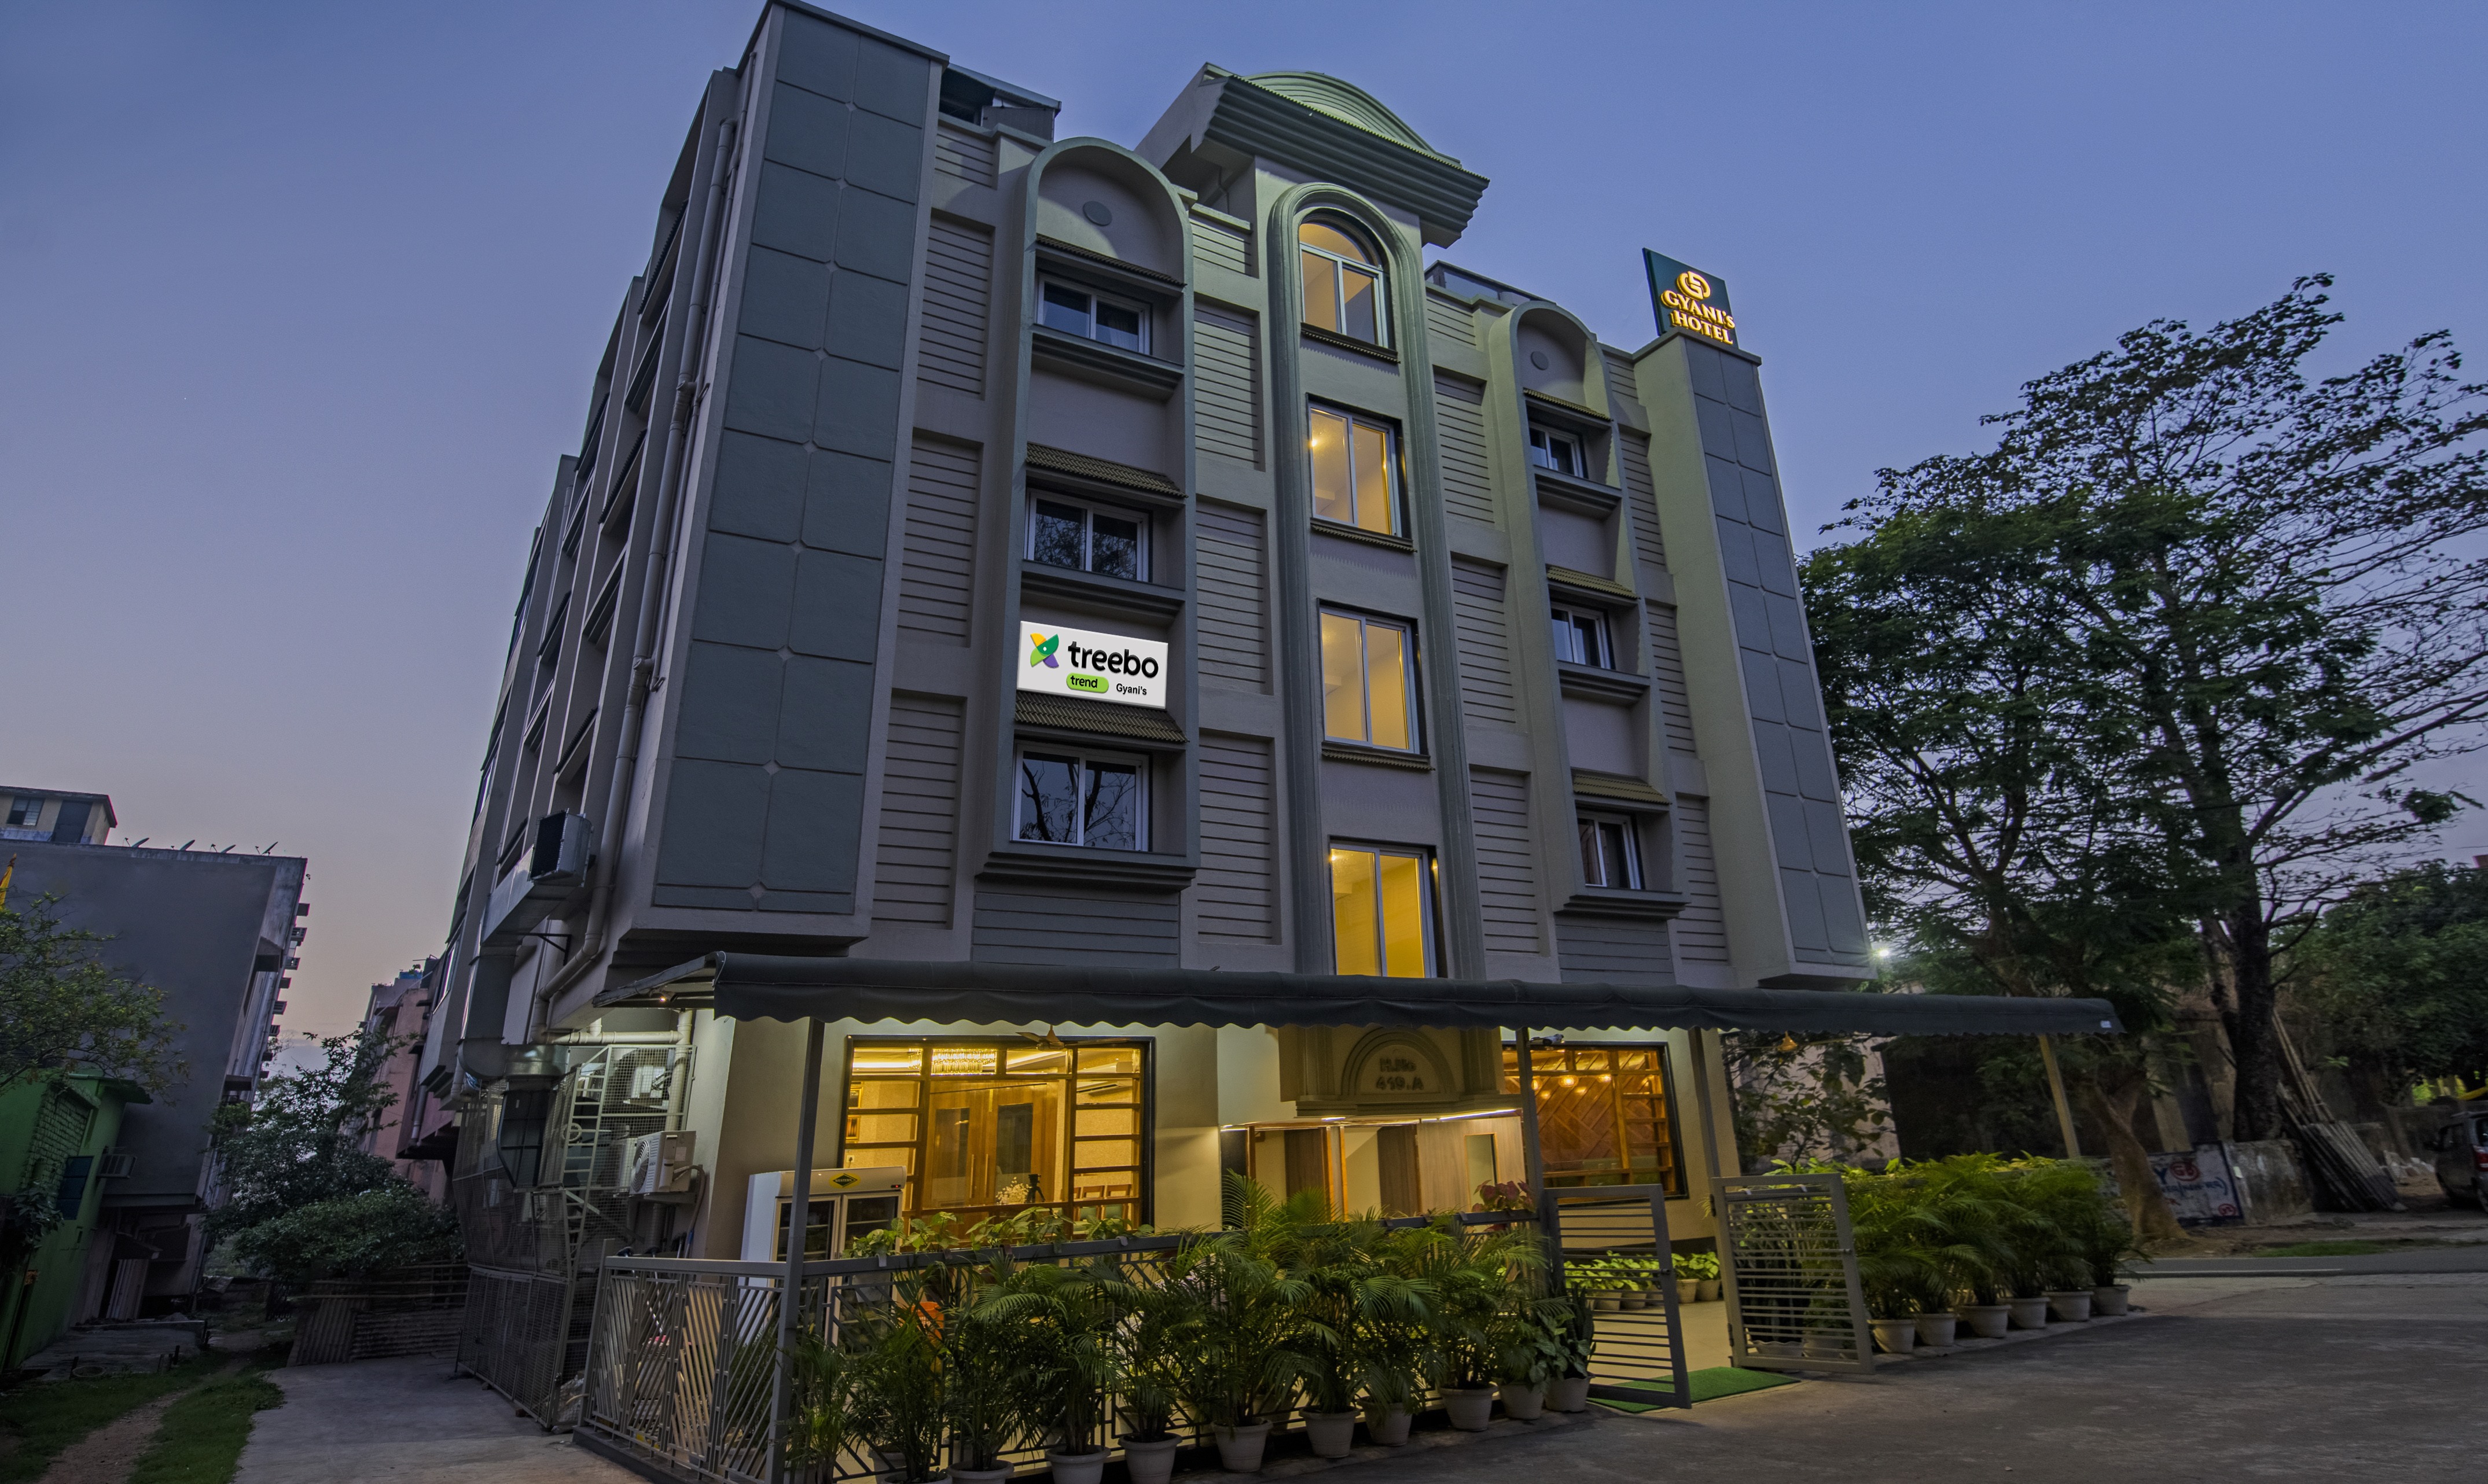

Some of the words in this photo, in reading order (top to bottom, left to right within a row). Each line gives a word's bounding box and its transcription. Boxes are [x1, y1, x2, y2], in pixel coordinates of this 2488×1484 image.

[1661, 290, 1735, 330] GYANI'S
[1670, 310, 1733, 345] HOTEL
[1068, 641, 1159, 678] treebo
[1070, 675, 1098, 688] trend
[1116, 683, 1147, 695] Gyani's
